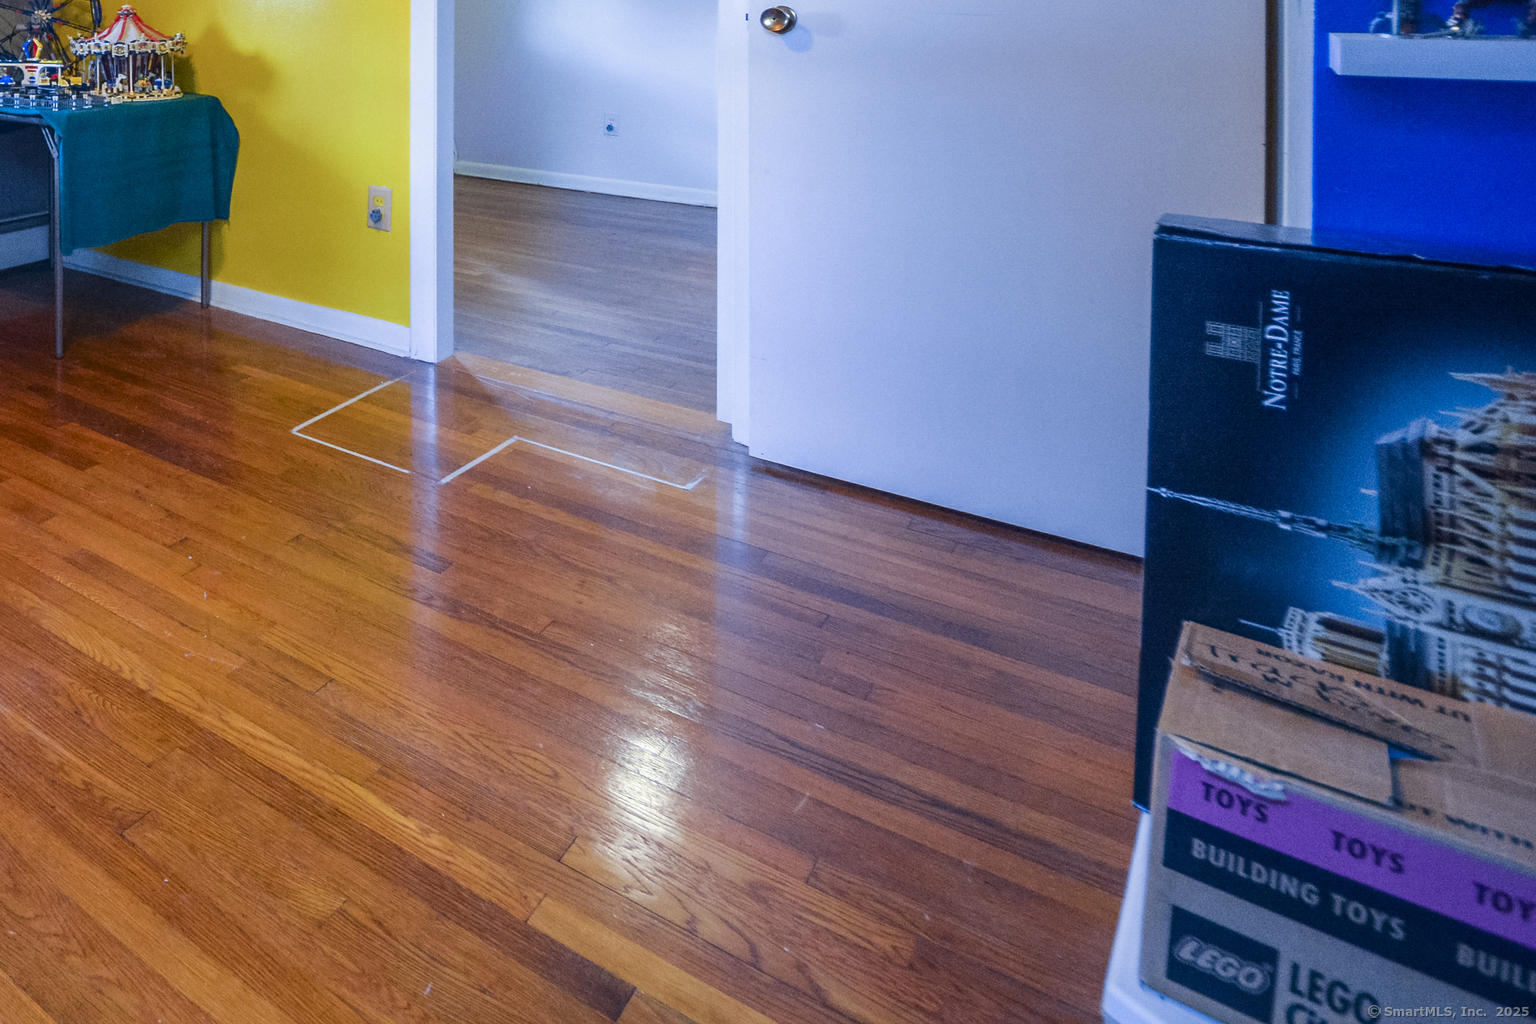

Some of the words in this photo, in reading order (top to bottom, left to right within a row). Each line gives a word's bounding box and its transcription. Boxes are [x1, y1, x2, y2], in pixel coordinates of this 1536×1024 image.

[1353, 678, 1427, 709] WITH
[1200, 780, 1269, 824] TOYS
[1330, 829, 1406, 875] TOYS
[1190, 837, 1320, 907] BUILDING
[1330, 891, 1407, 942] TOYS
[1175, 937, 1268, 992] LEGO
[1290, 961, 1381, 1024] LEGO
